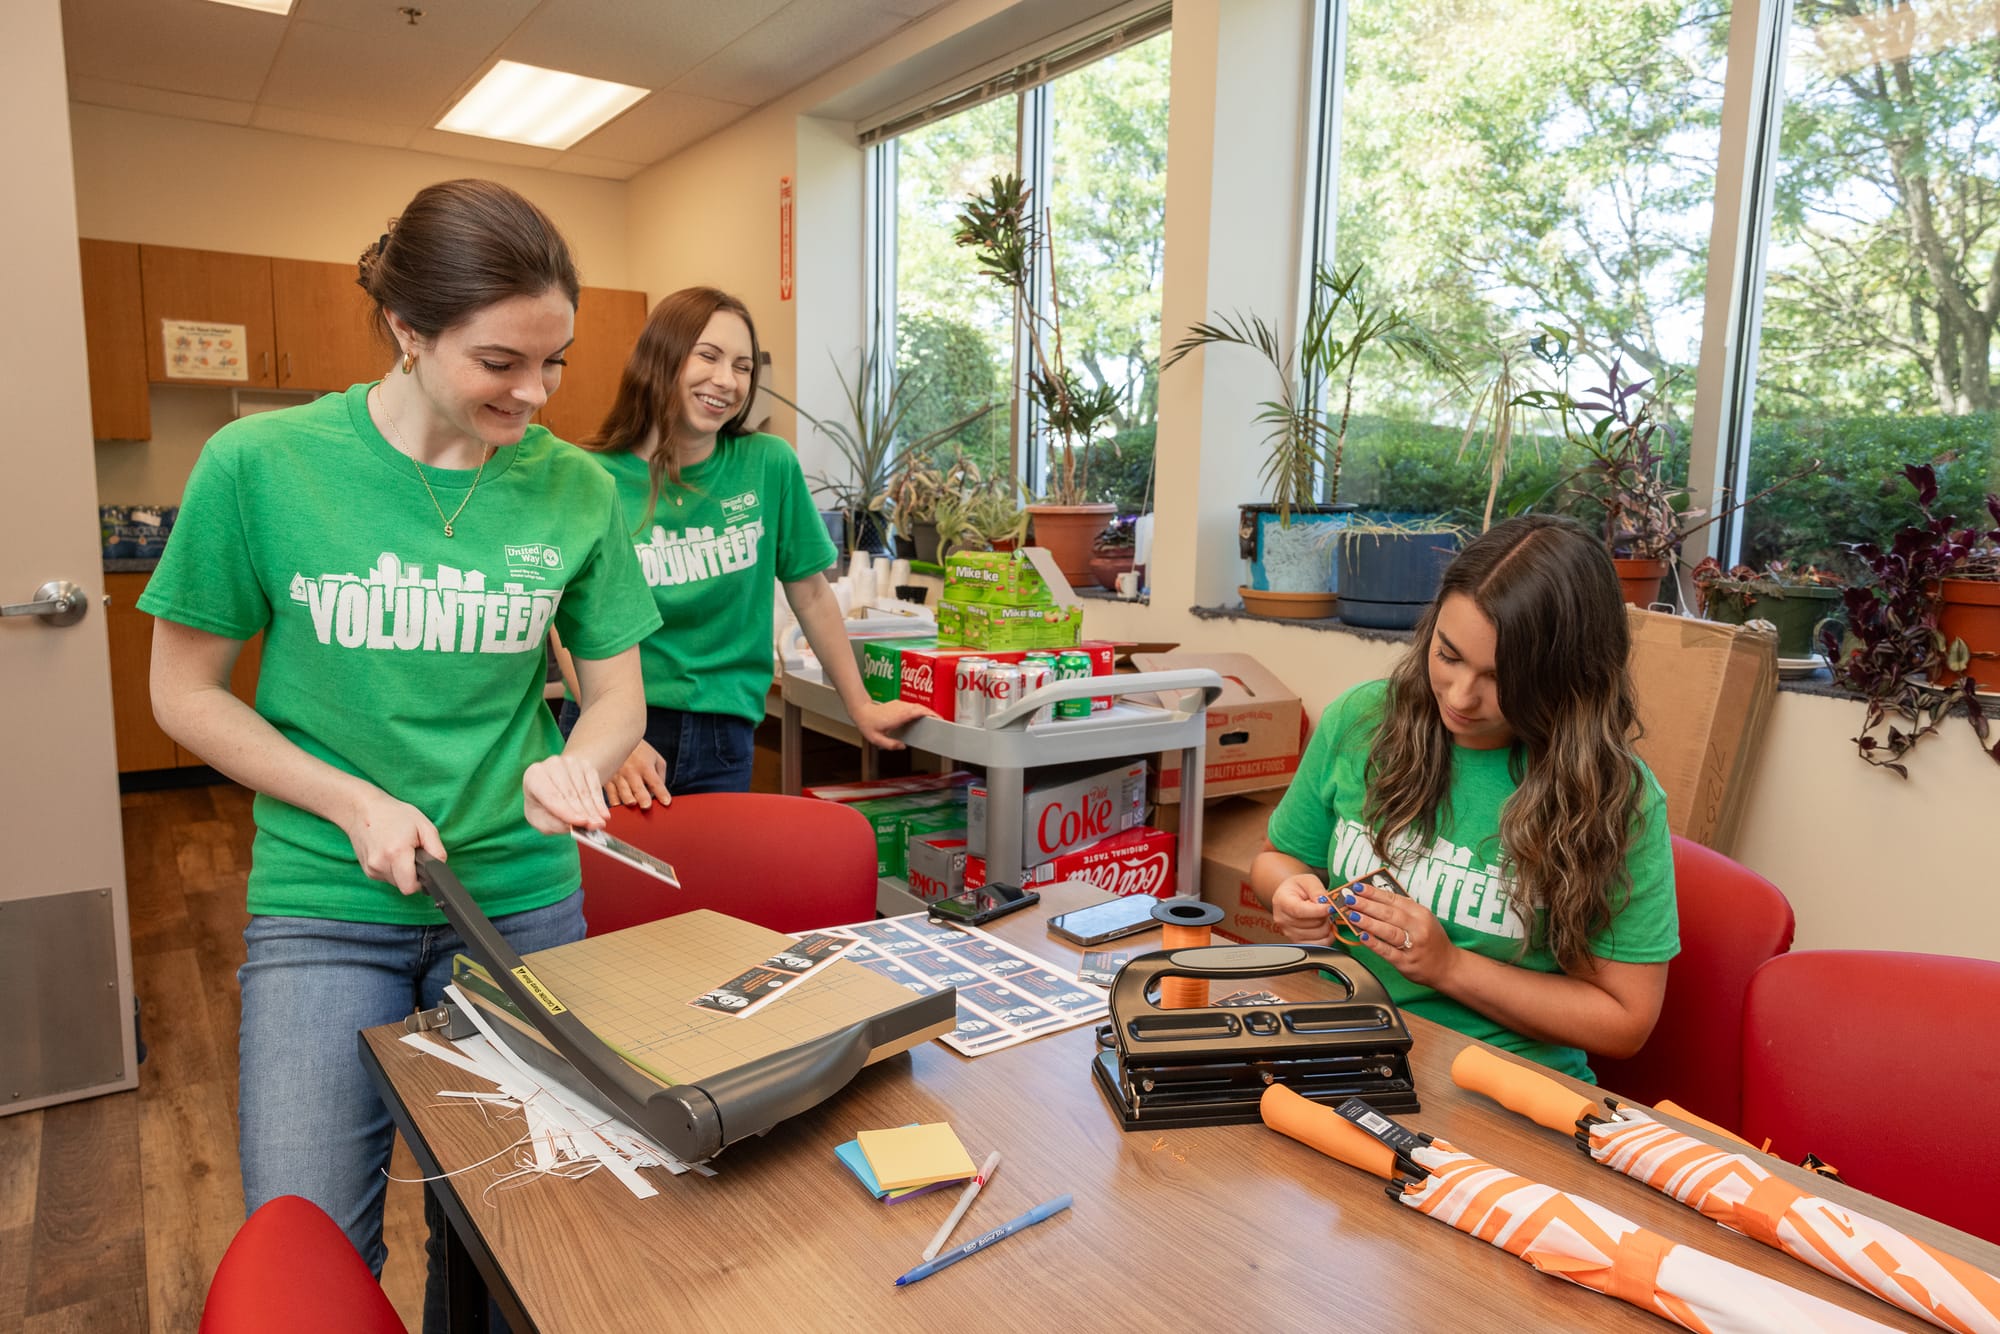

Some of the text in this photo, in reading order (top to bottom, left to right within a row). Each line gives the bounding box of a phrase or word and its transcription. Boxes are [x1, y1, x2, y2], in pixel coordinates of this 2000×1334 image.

[507, 545, 539, 556] United
[521, 554, 540, 566] Way
[956, 565, 999, 582] Mike Ike
[305, 579, 553, 654] VOLUNTEER
[1002, 608, 1044, 618] Mike Ike
[863, 653, 894, 680] Sprite
[956, 667, 984, 692] ok
[983, 673, 1010, 700] ke
[1037, 794, 1113, 854] Coke
[1083, 843, 1149, 865] ORIGINAL TASTE
